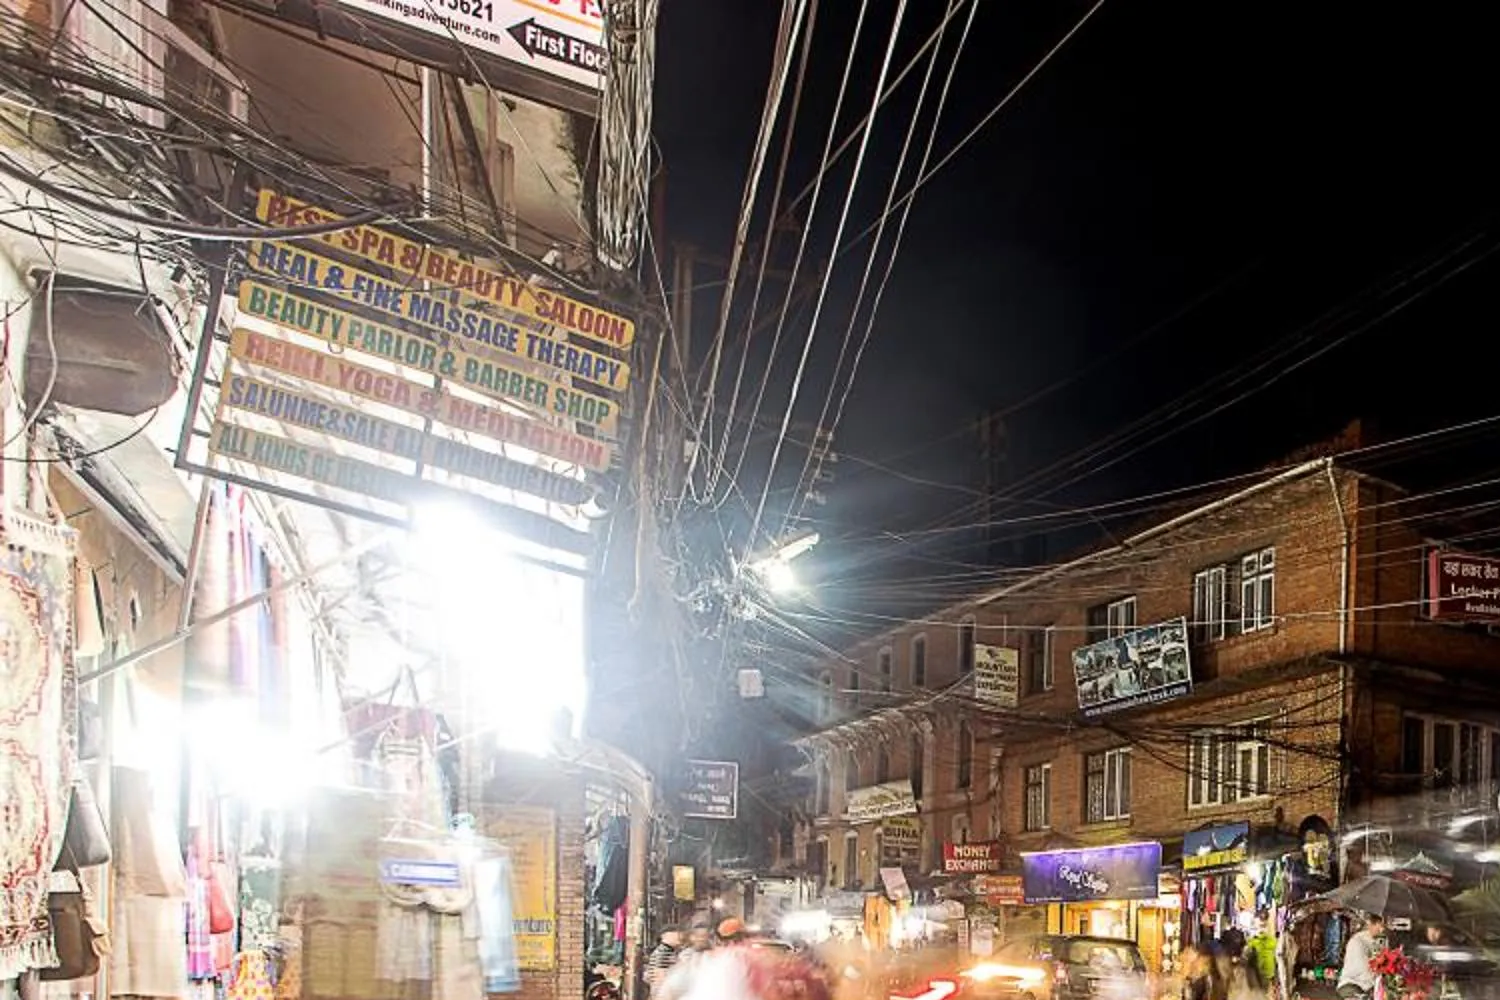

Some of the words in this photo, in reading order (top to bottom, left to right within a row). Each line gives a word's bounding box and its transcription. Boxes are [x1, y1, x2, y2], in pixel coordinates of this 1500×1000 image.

[524, 26, 565, 58] First
[569, 41, 608, 70] Floo
[258, 242, 319, 287] REAL
[324, 265, 345, 290] &
[352, 275, 404, 313] FINE
[408, 293, 519, 353] MASSAGE
[526, 332, 621, 387] THERAPY
[341, 226, 396, 264] SPA
[402, 243, 421, 270] &
[425, 250, 527, 307] BEAUTY
[535, 290, 627, 344] SALOON
[250, 285, 345, 341] BEAUTY
[347, 318, 437, 370] PARLOR
[438, 351, 456, 375] &
[463, 357, 549, 406] BARBER
[553, 387, 610, 425] SHOP
[339, 362, 411, 406] YOGA
[449, 403, 605, 466] MEDITATION
[953, 845, 990, 857] MONEY
